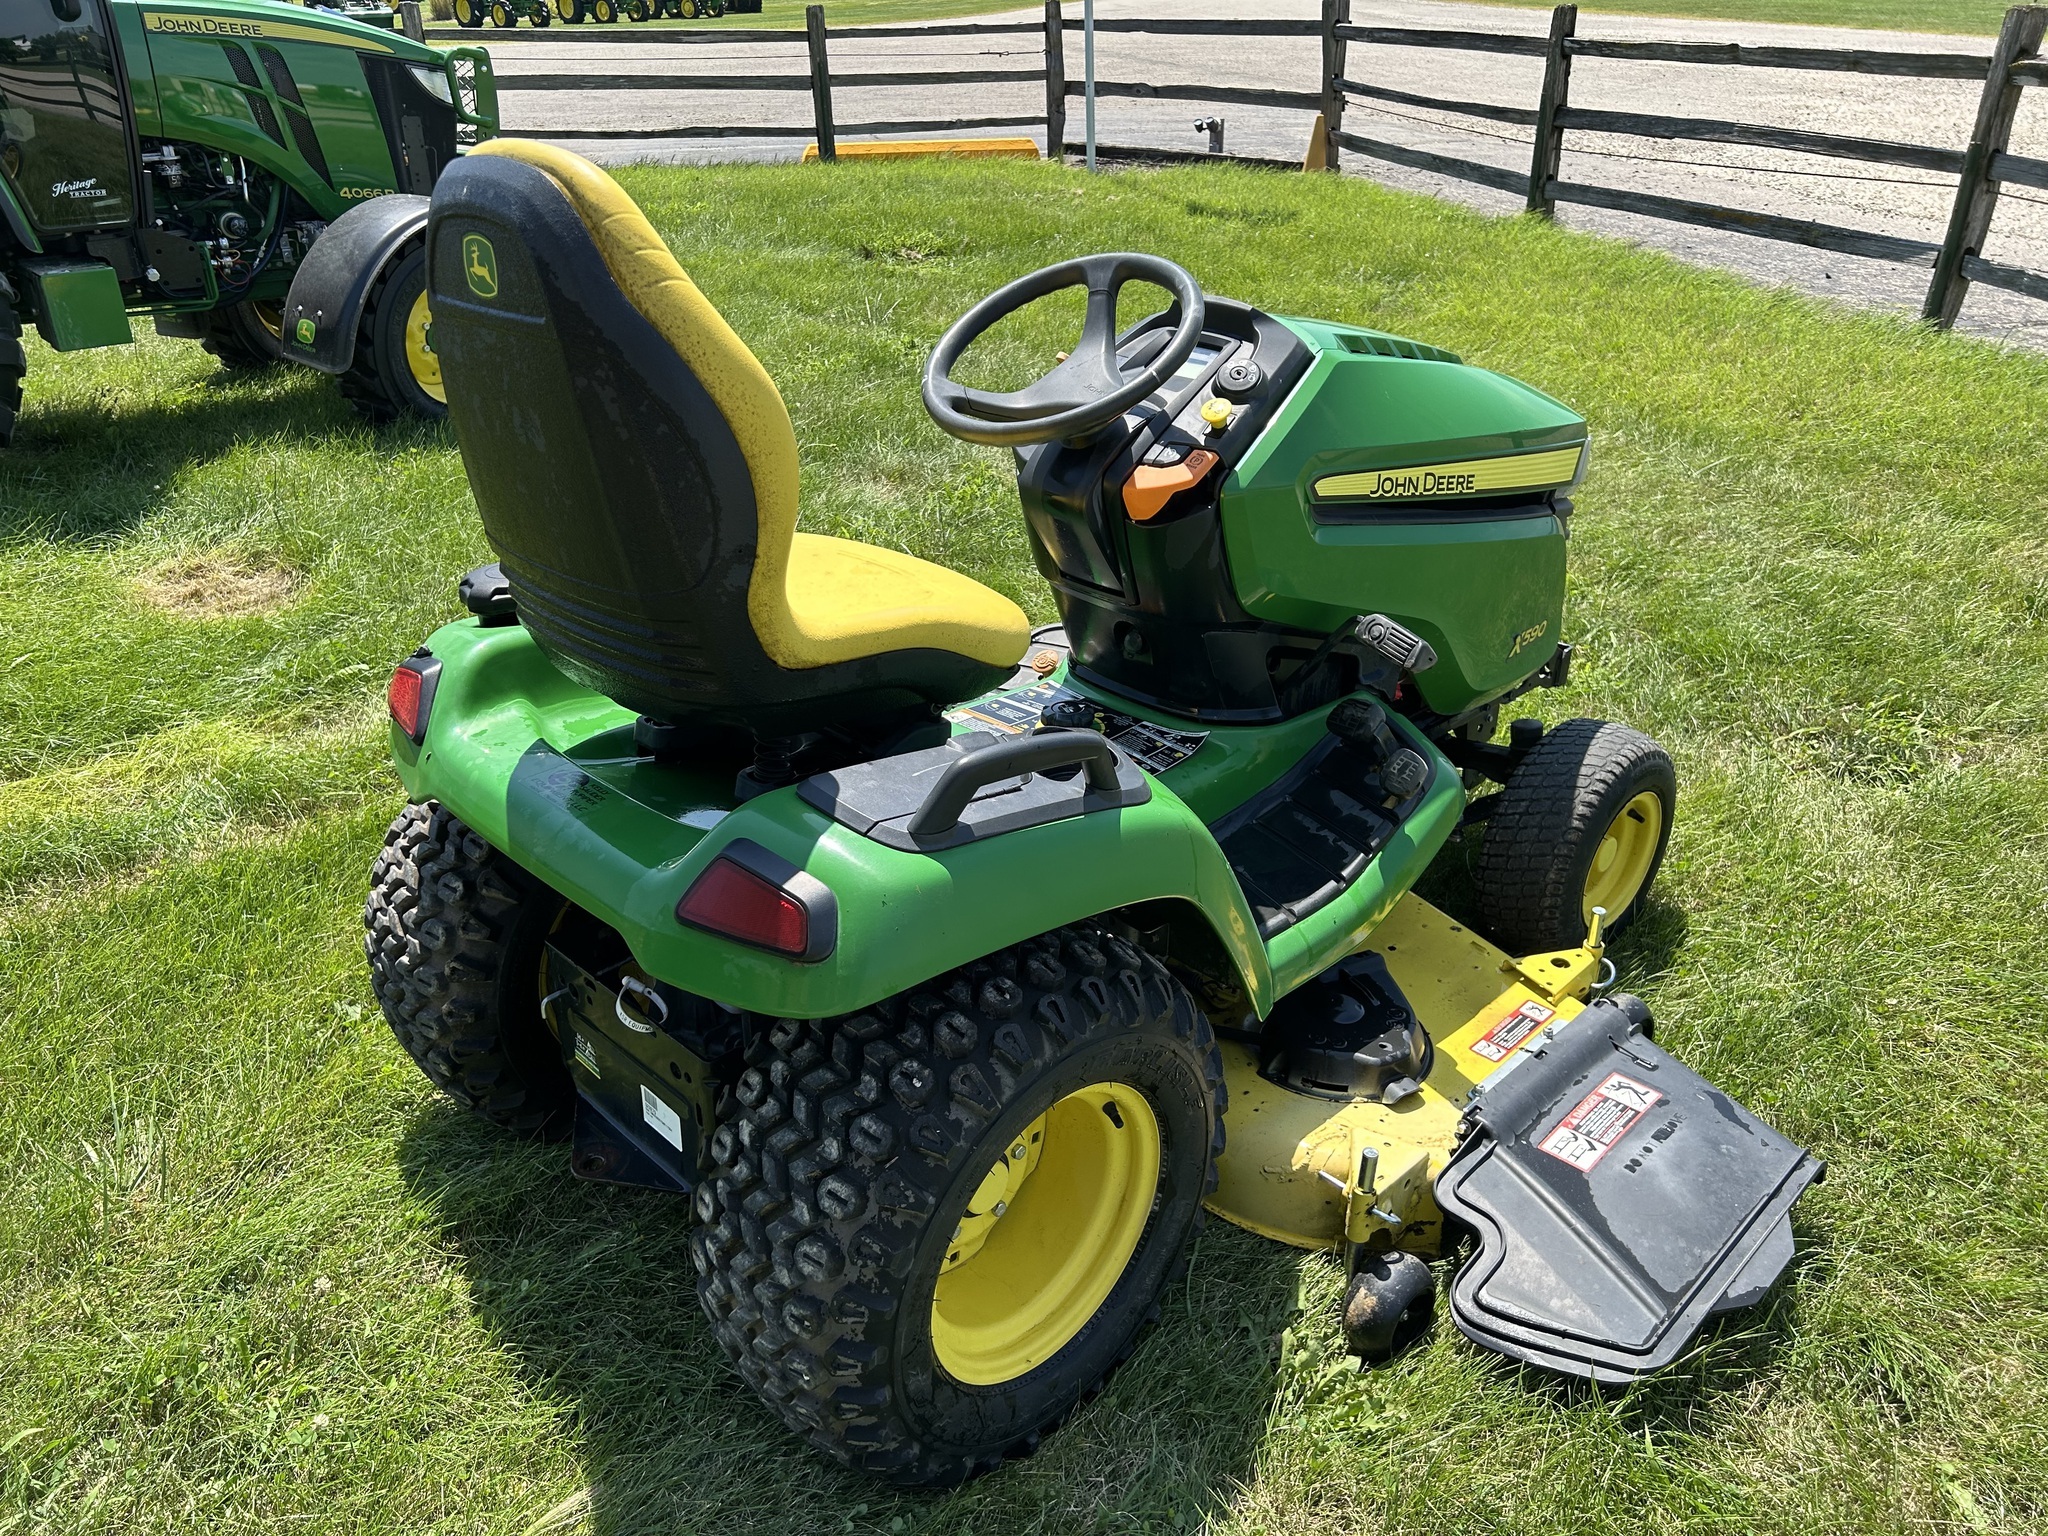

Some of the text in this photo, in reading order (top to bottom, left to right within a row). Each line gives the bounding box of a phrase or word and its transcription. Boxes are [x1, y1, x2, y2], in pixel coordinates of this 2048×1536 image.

[153, 16, 264, 36] JOHN DEERE
[52, 178, 97, 197] Heritage
[69, 189, 107, 198] TRACTOR
[1369, 471, 1476, 496] JOHN DEERE
[1506, 619, 1548, 659] X590
[1574, 1095, 1599, 1119] DANGER
[1636, 1140, 1658, 1161] NOT
[1650, 1112, 1688, 1144] ROVE
